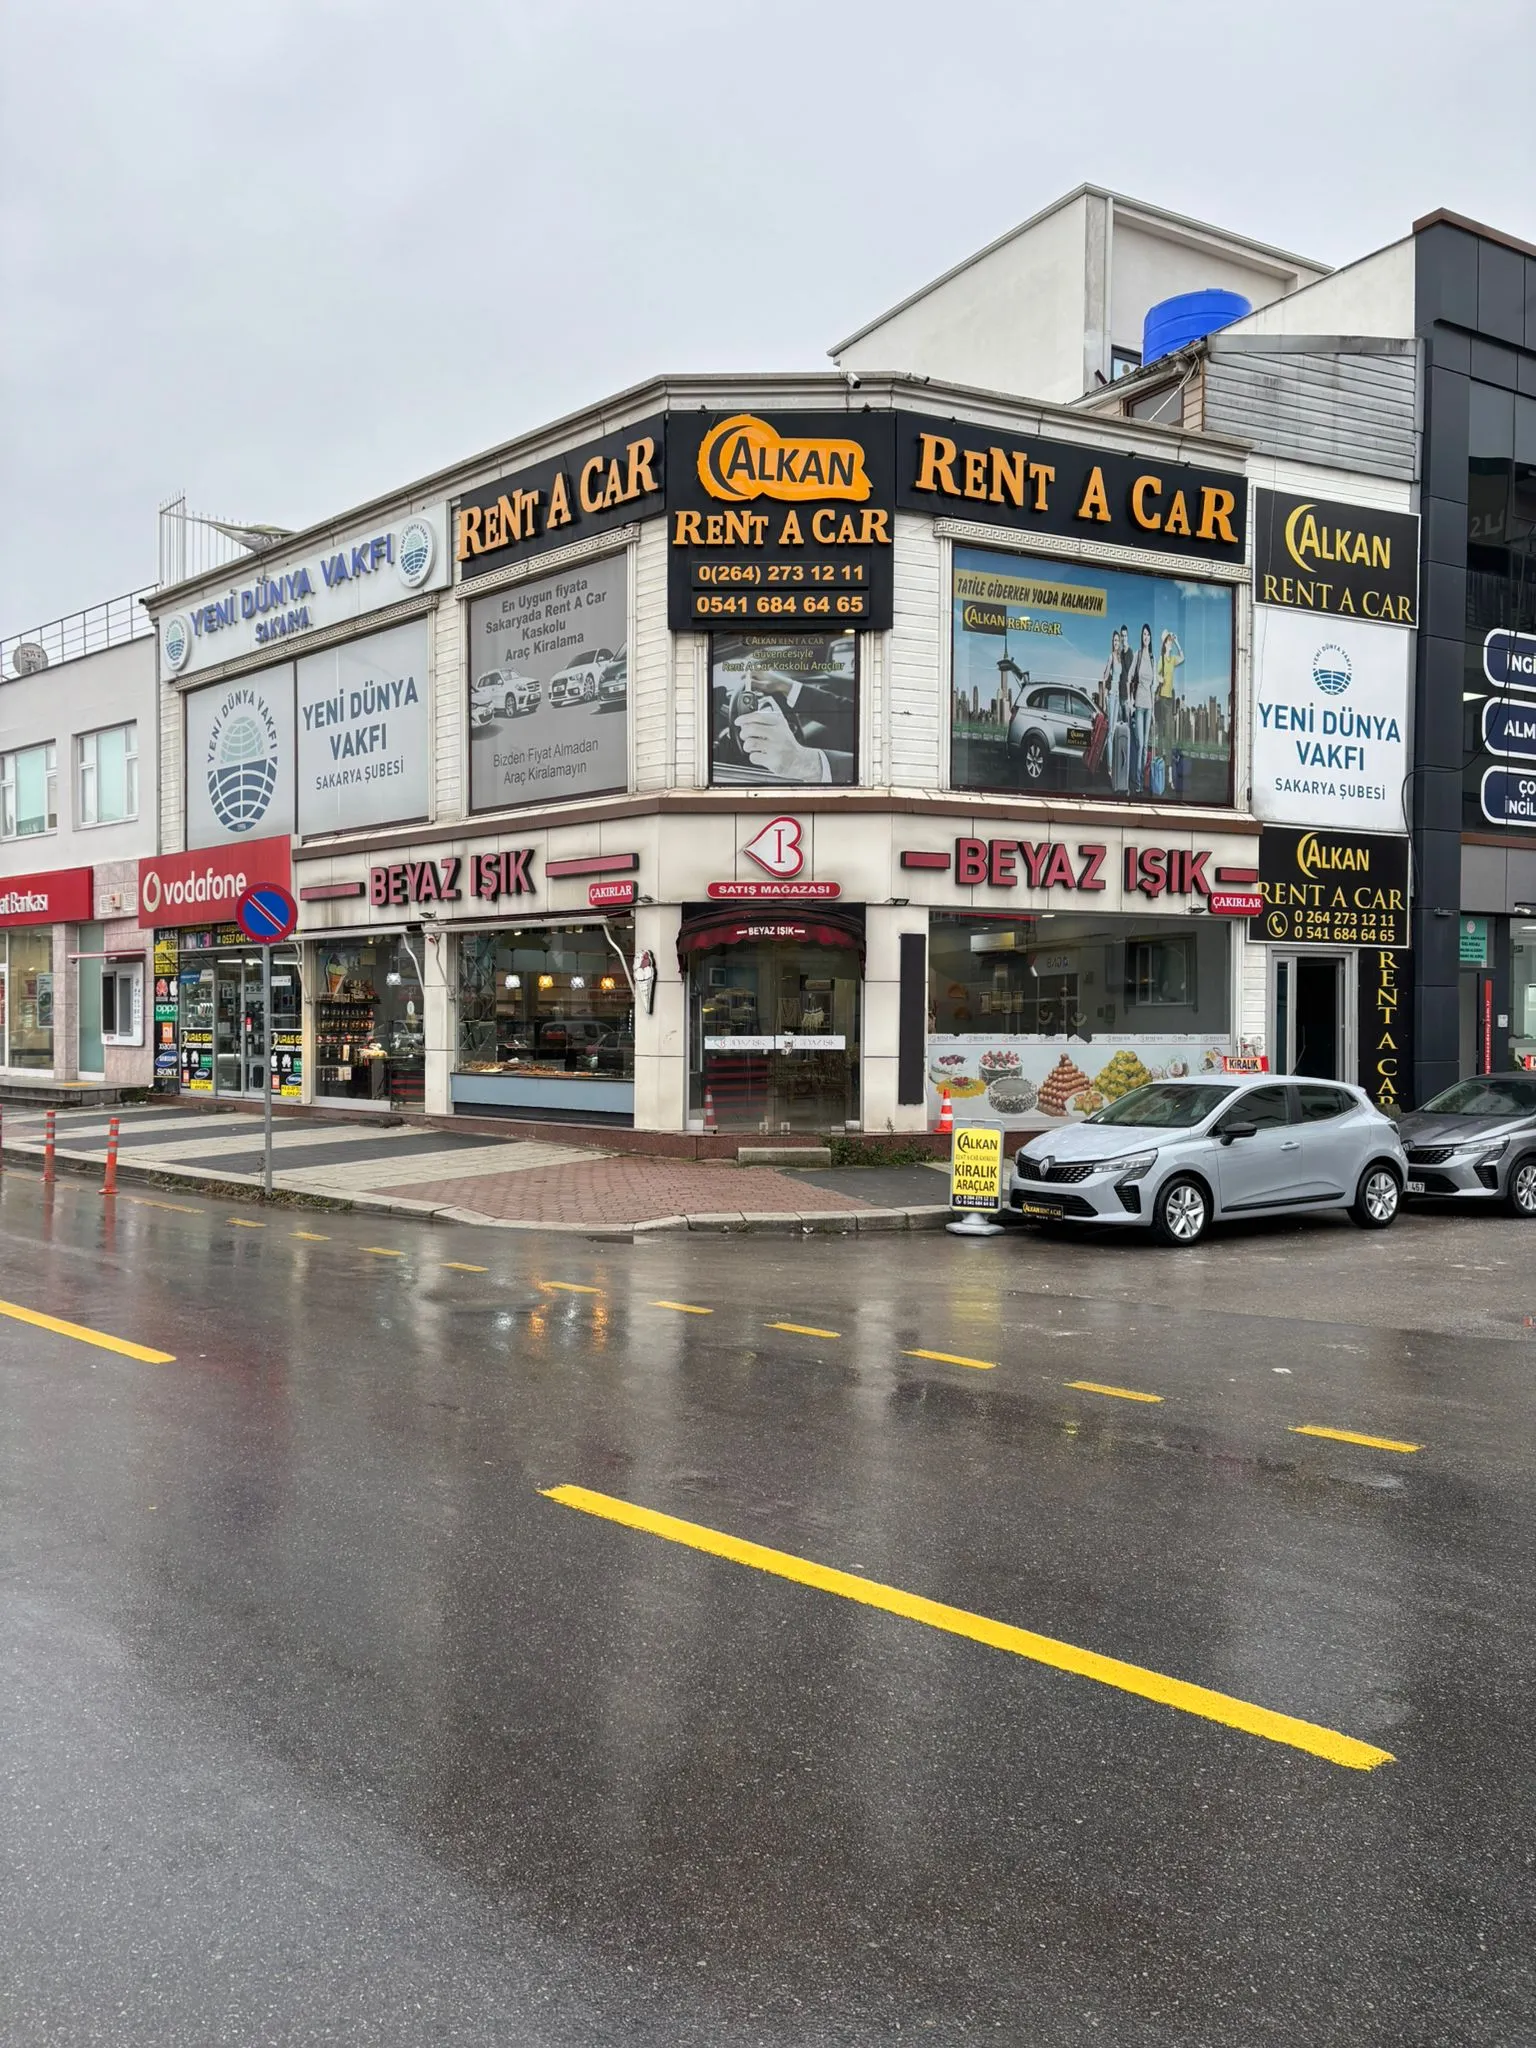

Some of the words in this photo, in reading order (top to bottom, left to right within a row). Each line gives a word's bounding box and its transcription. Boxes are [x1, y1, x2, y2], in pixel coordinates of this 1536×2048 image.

[456, 488, 539, 561] RENT
[547, 472, 572, 529] A
[580, 436, 658, 513] CAR
[915, 432, 1055, 511] RENT
[1078, 466, 1112, 522] A
[1132, 475, 1239, 543] CAR
[672, 510, 769, 545] RENT
[779, 510, 804, 544] A
[812, 509, 892, 544] CAR
[190, 589, 238, 636] YENİ
[241, 568, 316, 620] DÜNYA
[320, 533, 396, 587] VAKFI
[698, 565, 761, 584] 0(264)
[768, 566, 804, 581] 273
[811, 566, 834, 581] 12
[841, 566, 863, 581] 11
[502, 601, 515, 613] En
[518, 590, 552, 609] Uygun
[556, 580, 588, 598] fiyata
[697, 597, 747, 613] 0541
[756, 597, 796, 613] 684
[803, 597, 830, 613] 64
[836, 597, 863, 613] 65
[957, 577, 985, 596] TATİLE
[988, 580, 1030, 601] GİDERKEN
[1032, 588, 1058, 606] YOLDA
[1061, 592, 1103, 611] KALMAYIN
[1263, 574, 1333, 609] RENT
[1338, 588, 1356, 613] A
[1362, 591, 1414, 622] CAR
[255, 605, 313, 643] SAKARYA
[486, 609, 541, 634] Sakaryada
[545, 600, 571, 618] Rent
[574, 596, 582, 609] A
[586, 591, 607, 605] Car
[522, 620, 566, 640] Kaskolu
[505, 646, 530, 661] Araç
[533, 633, 584, 654] Kiralama
[303, 688, 345, 731] YENİ
[350, 676, 418, 719] DÜNYA
[221, 689, 255, 718] DÜNYA
[256, 696, 279, 750] VAKFI
[1258, 702, 1314, 733] YENİ
[1323, 706, 1401, 743] DÜNYA
[330, 723, 387, 760] VAKFI
[493, 752, 525, 767] Bizden
[528, 747, 551, 764] Fiyat
[554, 739, 599, 758] Almadan
[1296, 740, 1364, 771] VAKFI
[316, 770, 362, 790] SAKARYA
[364, 756, 404, 783] ŞUBESİ
[504, 771, 526, 785] Araç
[528, 762, 587, 780] Kiralamayın
[1275, 777, 1336, 796] SAKARYA
[1340, 784, 1386, 800] ŞUBESİ
[370, 857, 461, 906] BEYAZ
[470, 849, 536, 901] IŞIK
[956, 837, 1107, 890] BEYAZ
[1124, 846, 1213, 898] IŞIK
[163, 867, 248, 905] vodafone
[590, 885, 632, 901] ÇAKIRLAR
[718, 885, 757, 896] SATIŞ
[761, 884, 830, 894] MAĞAZASI
[1257, 881, 1326, 907] RENT
[1330, 886, 1348, 908] A
[1354, 886, 1406, 911] CAR
[1212, 895, 1262, 909] ÇAKIRLAR
[748, 926, 775, 936] BEYAZ
[777, 926, 795, 935] IŞIK
[1295, 910, 1303, 923] 0
[1306, 911, 1331, 924] 264
[1334, 912, 1357, 925] 273
[1362, 914, 1376, 926] 12
[1380, 915, 1395, 927] 11
[1295, 926, 1303, 938] 0
[1306, 926, 1330, 939] 541
[1334, 928, 1357, 940] 684
[1361, 929, 1376, 941] 64
[1380, 929, 1395, 942] 65
[1376, 951, 1400, 1024] RENT
[156, 1005, 178, 1014] oppo
[1376, 1032, 1398, 1049] A
[955, 1161, 997, 1178] KİRALIK
[956, 1179, 995, 1193] ARAÇLAR
